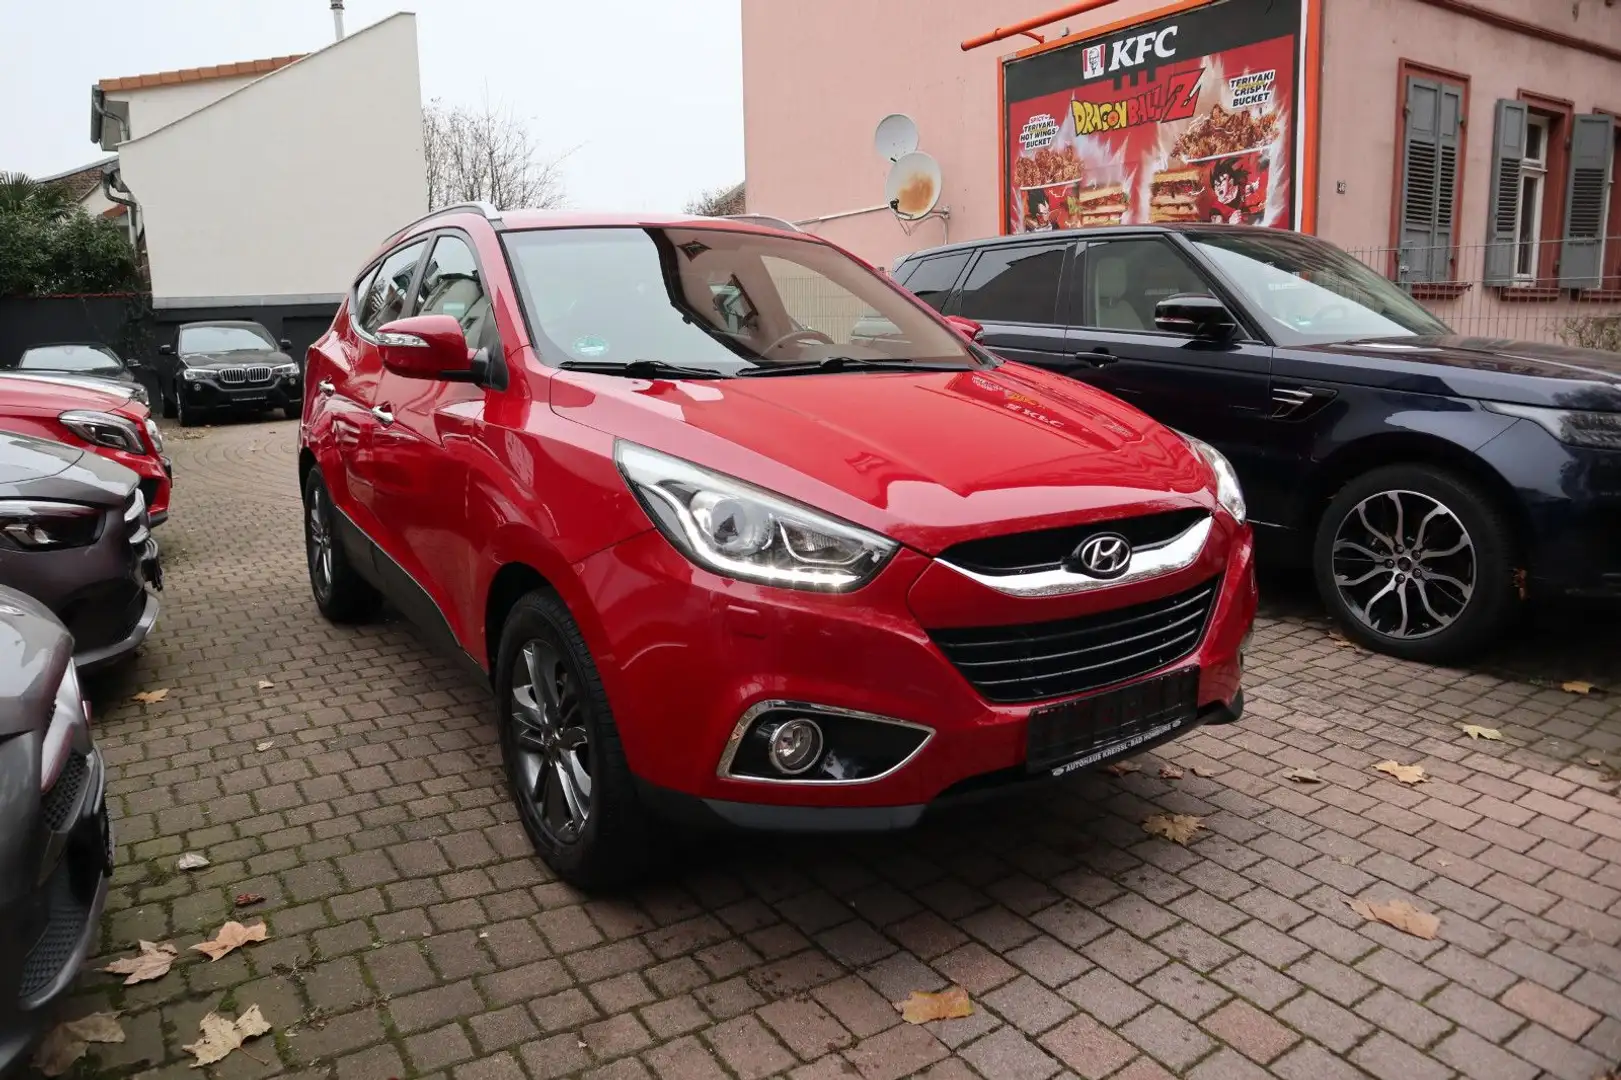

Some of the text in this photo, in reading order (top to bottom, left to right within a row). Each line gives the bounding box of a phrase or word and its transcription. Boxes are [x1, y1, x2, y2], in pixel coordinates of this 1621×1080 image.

[1109, 25, 1179, 72] KFC
[1231, 72, 1273, 88] TERIYAKI
[1235, 82, 1268, 97] CRISPY
[1071, 100, 1128, 136] DRAGON
[1161, 68, 1205, 123] Z
[1233, 92, 1270, 107] BUCKET
[1024, 120, 1053, 132] TERIYAKI
[1020, 133, 1033, 142] HOT
[1034, 127, 1056, 138] WINGS
[1026, 137, 1051, 148] BUCKET
[1066, 753, 1102, 772] AUTOHAUS
[1102, 742, 1128, 759] KREISSL
[1130, 735, 1143, 747] BAD
